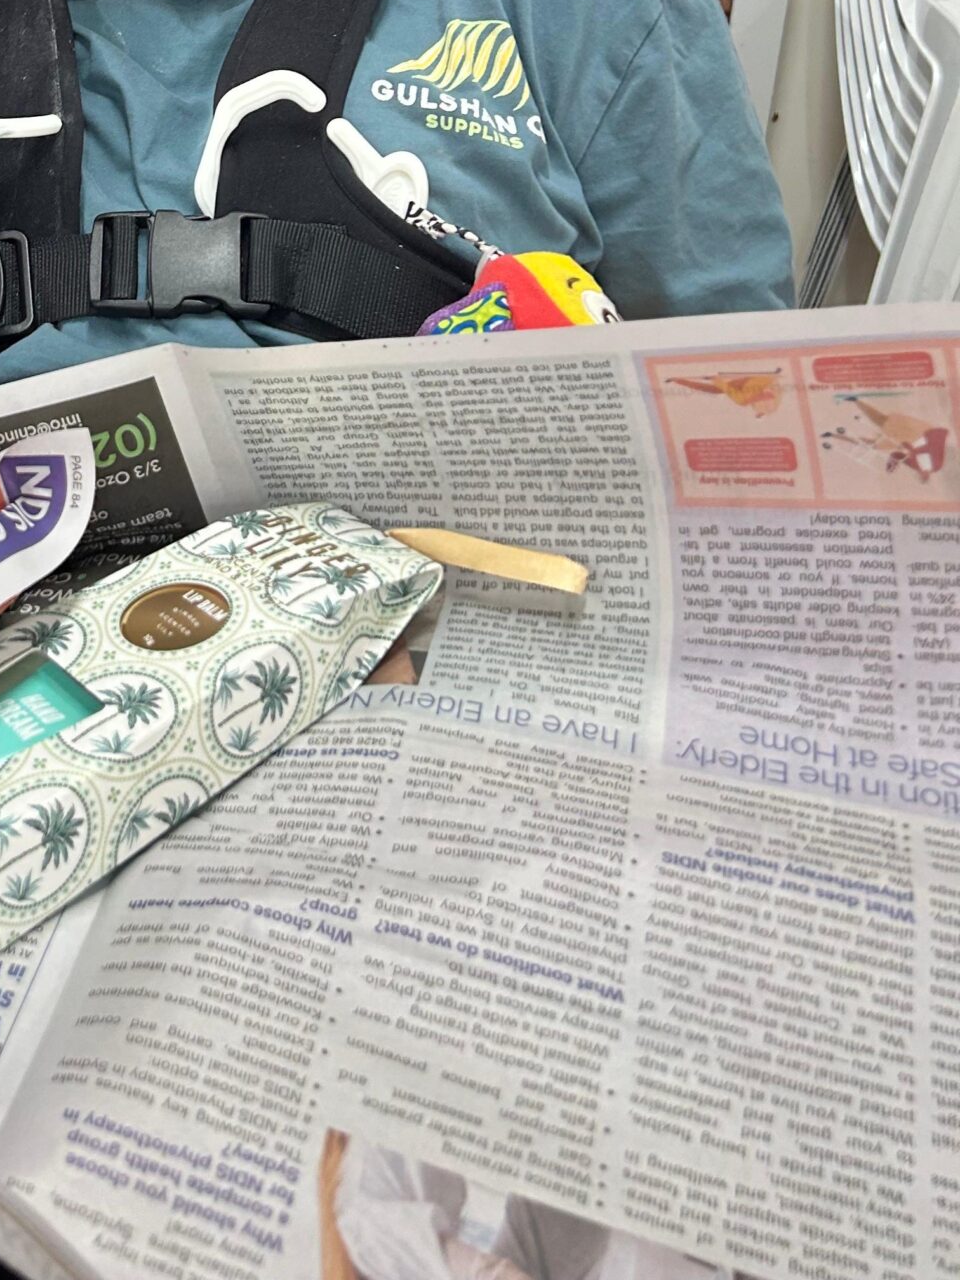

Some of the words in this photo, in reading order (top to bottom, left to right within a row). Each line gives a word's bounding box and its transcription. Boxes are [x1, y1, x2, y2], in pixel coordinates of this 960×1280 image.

[70, 454, 83, 490] PAGE
[94, 471, 130, 489] Ozo
[133, 459, 161, 480] 3/3
[70, 491, 79, 509] 84
[130, 507, 172, 527] team
[453, 507, 476, 518] bulk
[478, 508, 500, 518] add
[504, 508, 538, 519] would
[542, 505, 592, 518] program
[594, 508, 645, 520] exercise
[699, 524, 718, 536] get
[728, 524, 785, 537] program,
[795, 528, 848, 539] exercise
[859, 530, 892, 541] lored
[708, 541, 730, 551] and
[824, 541, 893, 556] prevention
[182, 589, 203, 603] LIP
[197, 599, 228, 621] BALM
[763, 601, 801, 613] adults
[806, 602, 840, 615] older
[381, 687, 483, 721] Elderly
[494, 704, 532, 727] an
[542, 714, 619, 749] have
[630, 732, 638, 753] I
[740, 725, 838, 767] Home
[341, 748, 400, 760] Contact
[675, 738, 788, 783] Elderly:
[848, 746, 878, 769] at
[799, 766, 849, 795] the
[862, 780, 887, 800] in
[899, 785, 960, 814] tion
[661, 851, 706, 872] NDIS
[712, 862, 774, 886] mobile
[779, 880, 810, 897] our
[815, 888, 859, 909] does
[128, 899, 173, 910] health
[178, 898, 249, 912] complete
[299, 898, 358, 920] group?
[865, 901, 915, 924] What
[253, 904, 312, 929] choose
[316, 920, 353, 946] Why
[374, 918, 422, 942] treat?
[426, 933, 452, 950] we
[456, 941, 479, 957] do
[7, 964, 26, 981] in
[483, 948, 572, 986] conditions
[577, 979, 625, 1003] What
[63, 1107, 81, 1123] in
[66, 1129, 120, 1158] group
[65, 1151, 130, 1190] choose
[124, 1151, 181, 1185] health
[221, 1143, 300, 1183] Sydney?
[215, 1163, 263, 1194] NDIS
[134, 1179, 167, 1203] you
[185, 1176, 274, 1220] complete
[268, 1183, 295, 1207] for
[171, 1195, 236, 1231] should
[240, 1220, 284, 1255] Why
